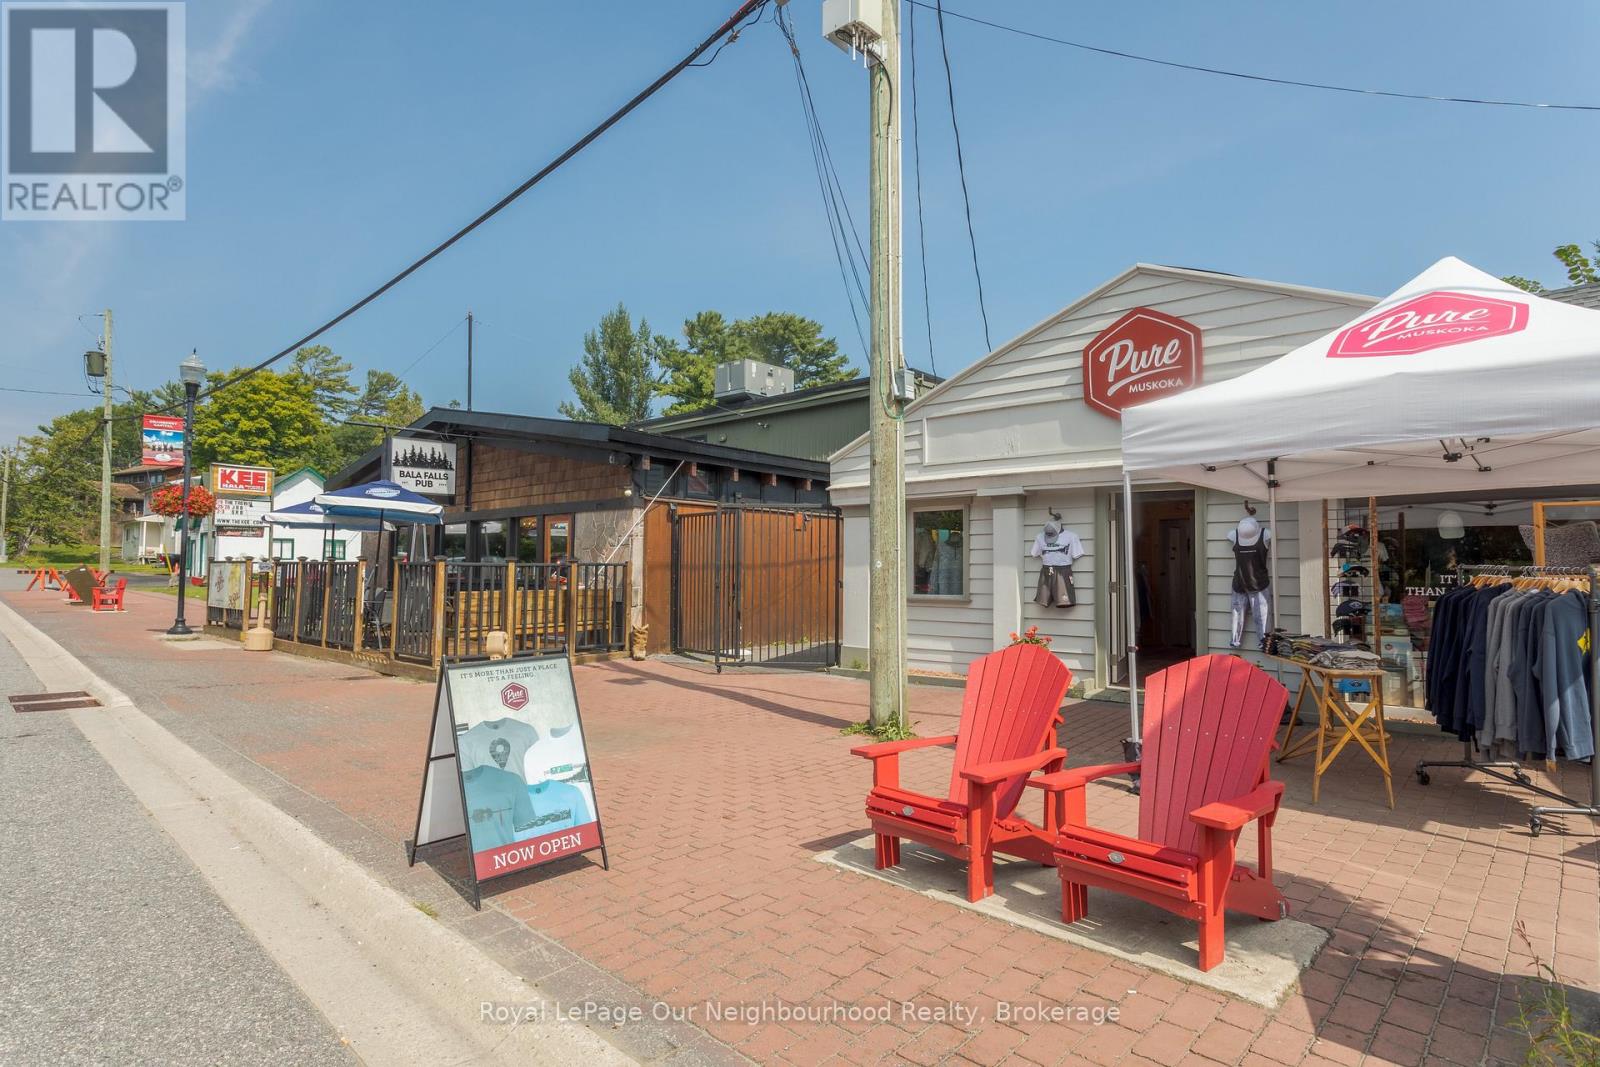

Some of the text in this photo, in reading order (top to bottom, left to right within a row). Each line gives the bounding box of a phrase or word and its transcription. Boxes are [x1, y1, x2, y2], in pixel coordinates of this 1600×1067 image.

[1360, 308, 1489, 340] Pure
[1397, 324, 1489, 341] MUSKOKA
[1099, 338, 1182, 382] Pure
[1128, 378, 1184, 394] MUSKOKA
[220, 468, 266, 487] KEE
[400, 470, 449, 481] BALA FALLS
[415, 479, 433, 488] PUB
[475, 670, 494, 678] MORE
[495, 668, 514, 676] THAN
[538, 663, 558, 671] PLACE
[493, 833, 582, 869] NOW OPEN
